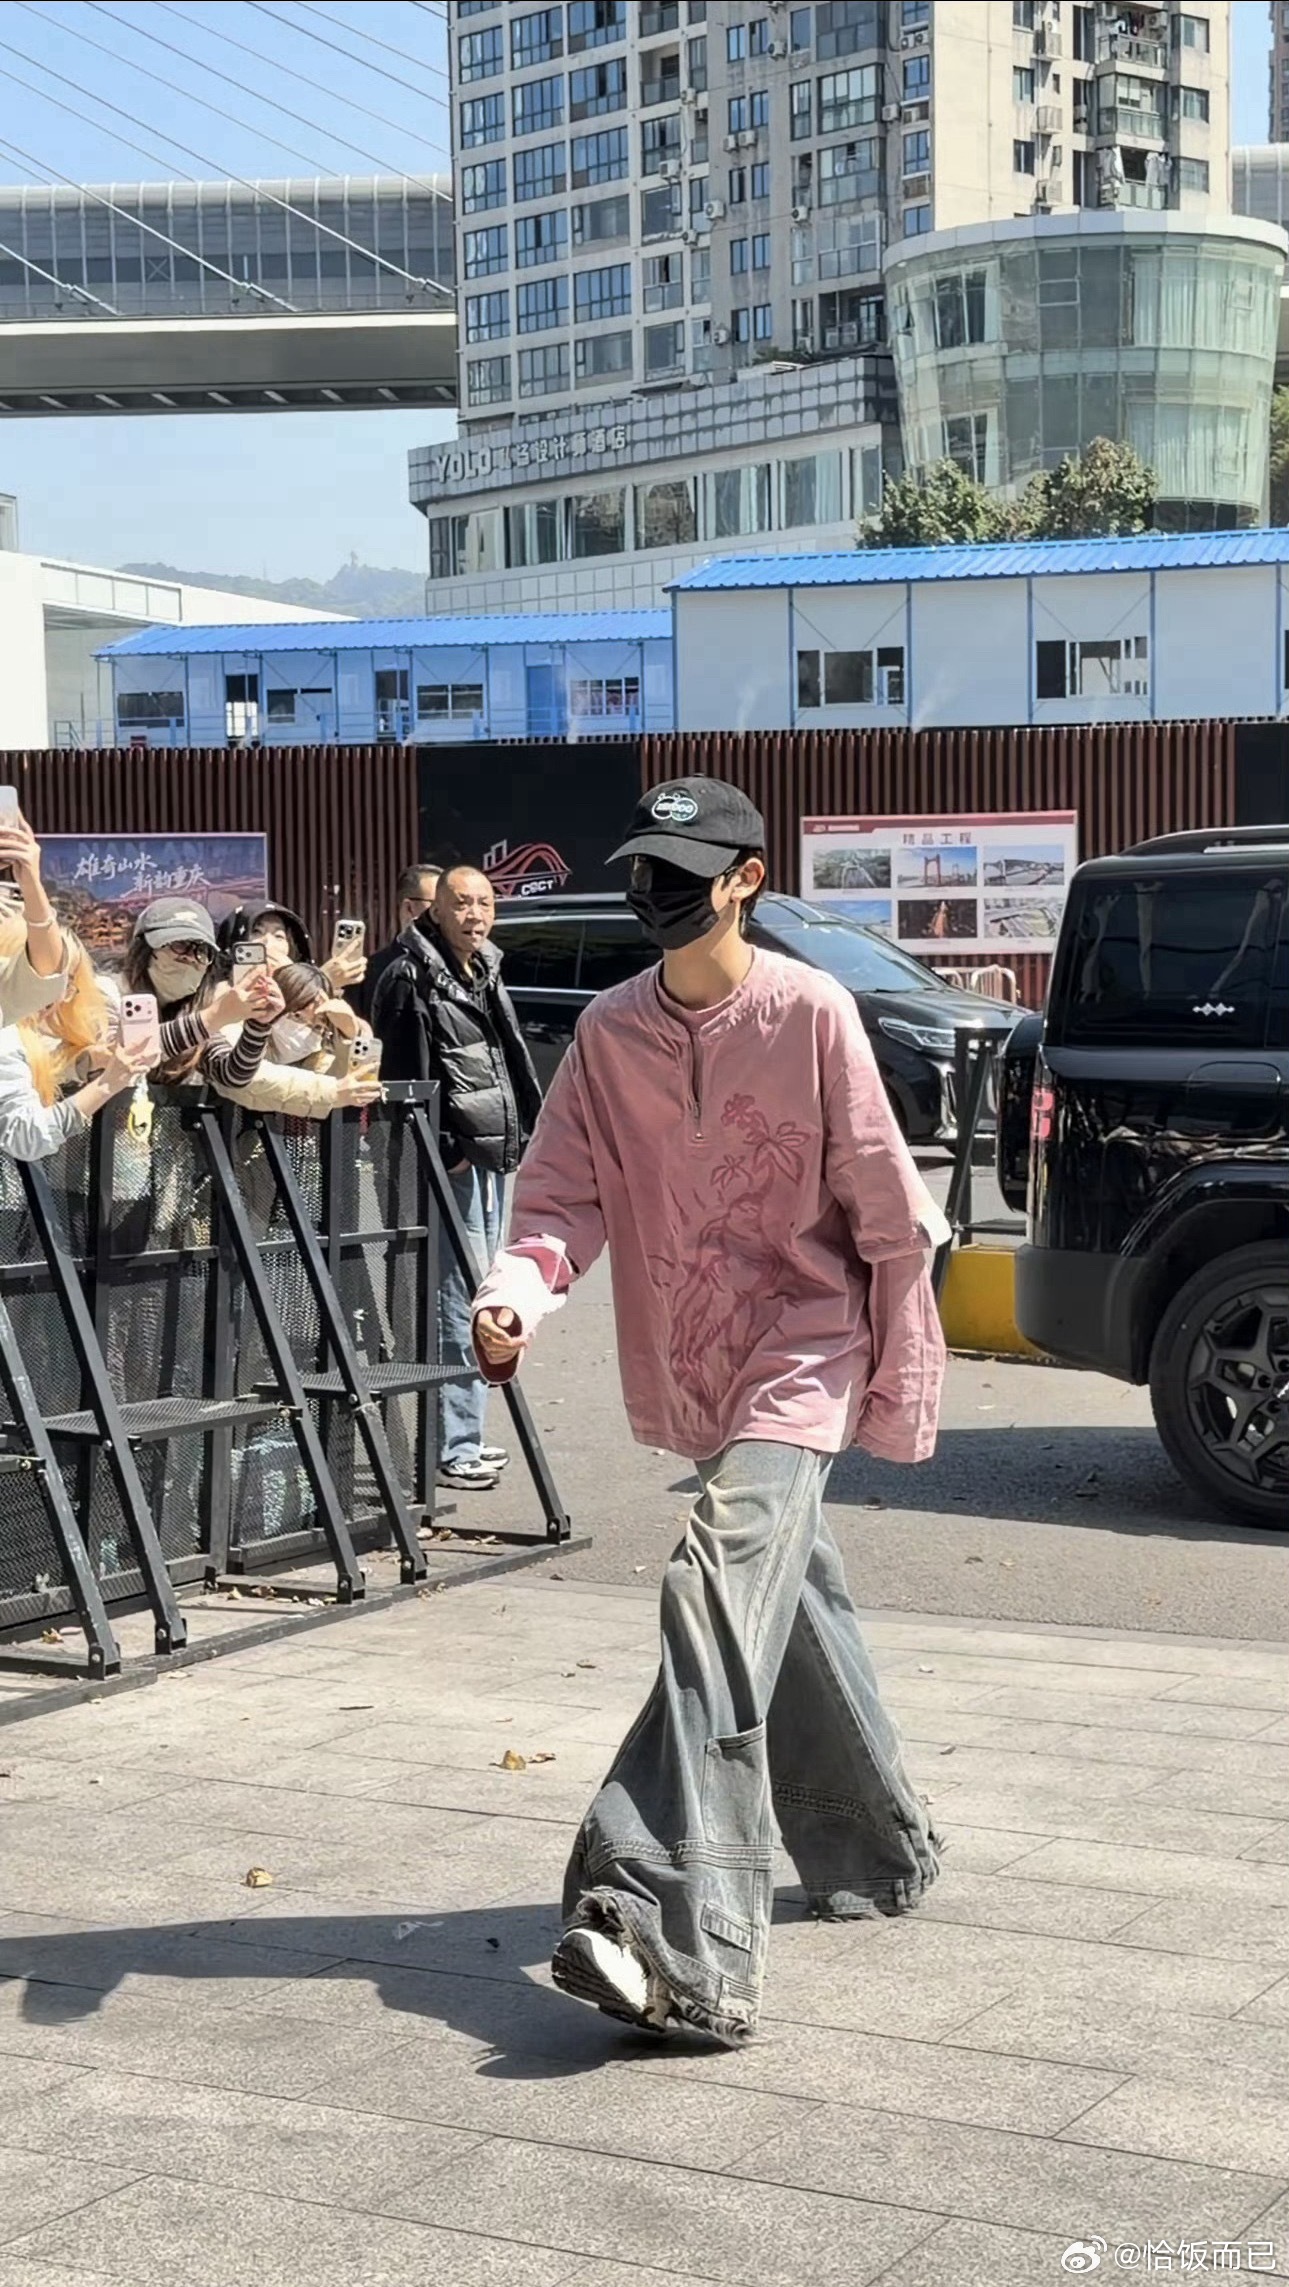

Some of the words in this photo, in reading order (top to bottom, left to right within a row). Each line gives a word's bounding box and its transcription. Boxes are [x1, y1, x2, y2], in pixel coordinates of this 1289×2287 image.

[433, 449, 493, 483] YOLO
[902, 831, 972, 845] 精品工程
[73, 851, 159, 882] 雄奇山水
[120, 863, 211, 898] 新韵重庆
